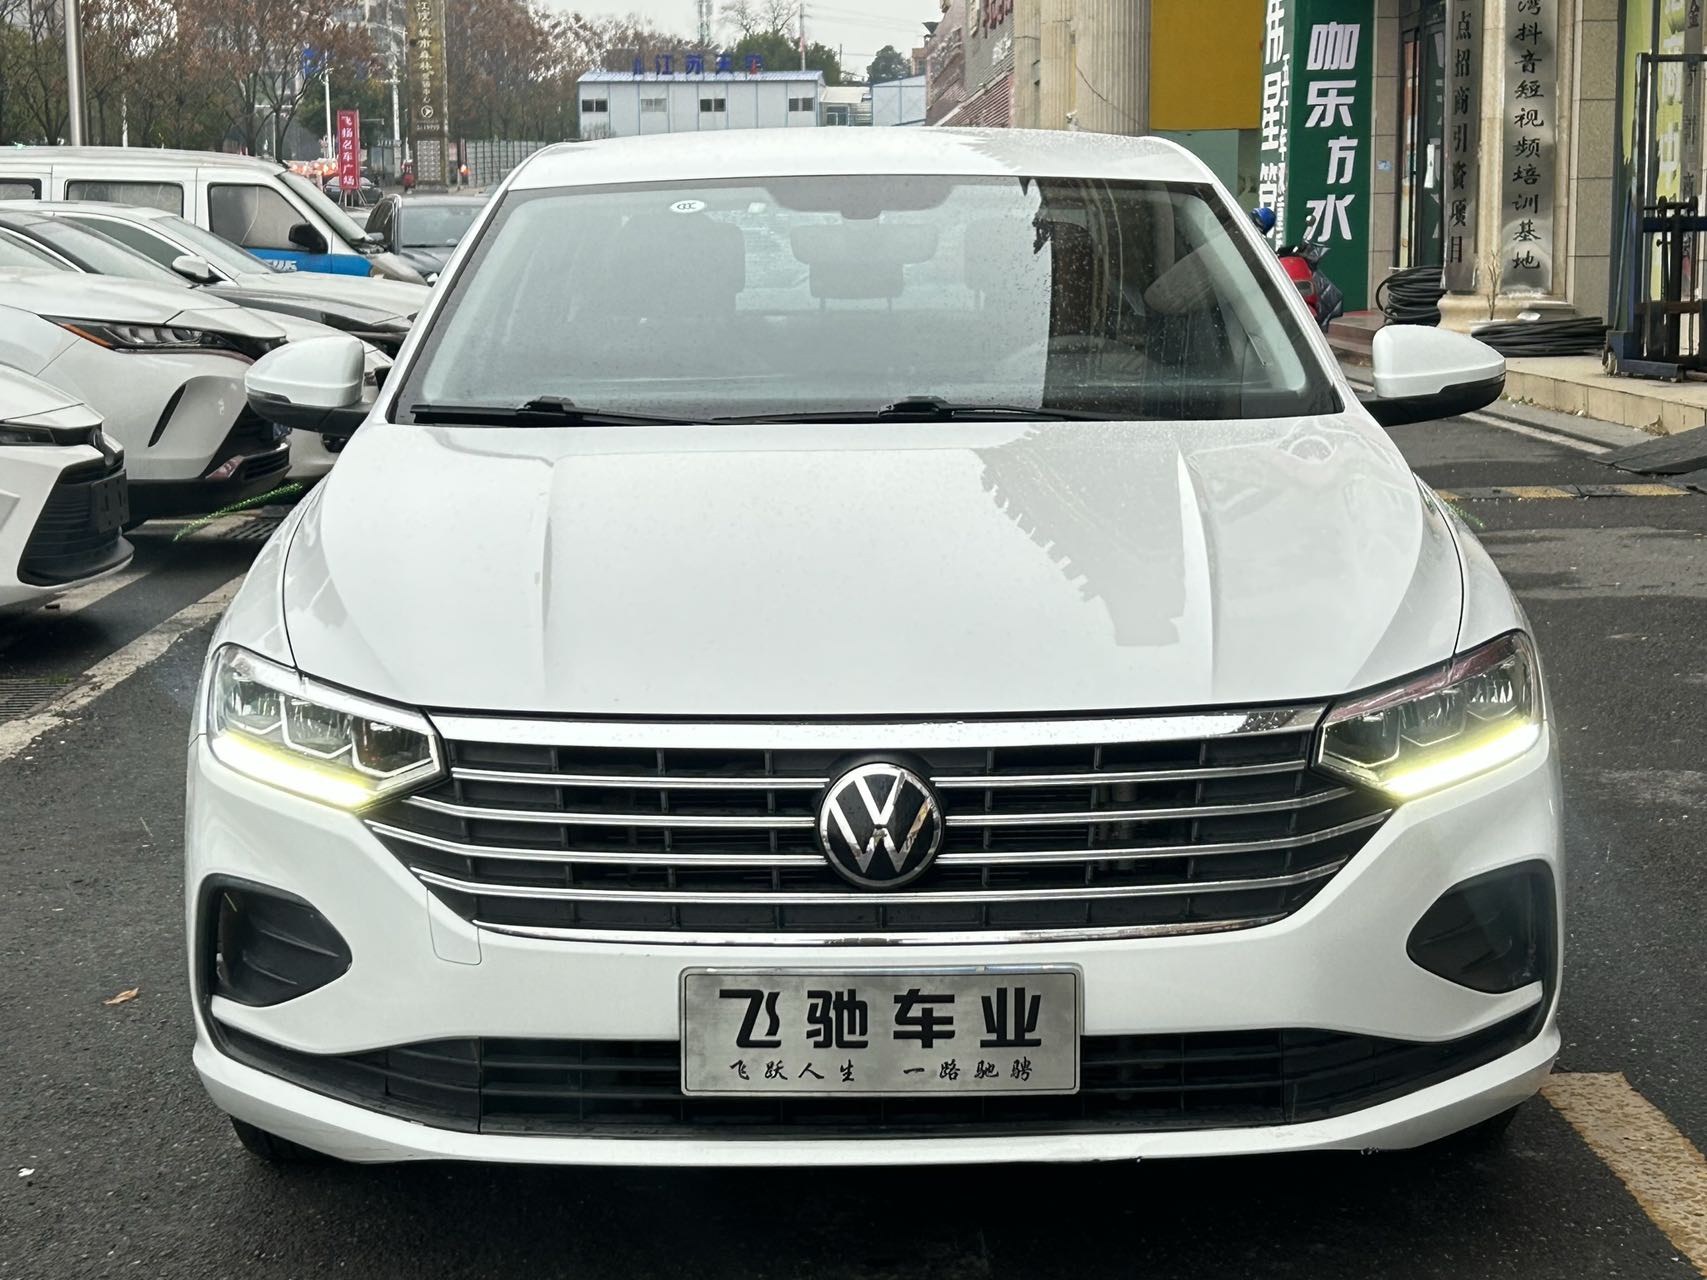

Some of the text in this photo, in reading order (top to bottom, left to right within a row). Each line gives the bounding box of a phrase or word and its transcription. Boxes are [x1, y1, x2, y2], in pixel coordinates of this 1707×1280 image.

[1450, 0, 1473, 264] 点招商引资项目
[719, 987, 1042, 1049] 飞驰车业
[729, 1056, 1034, 1083] 飞跃人生 一路驰骋
